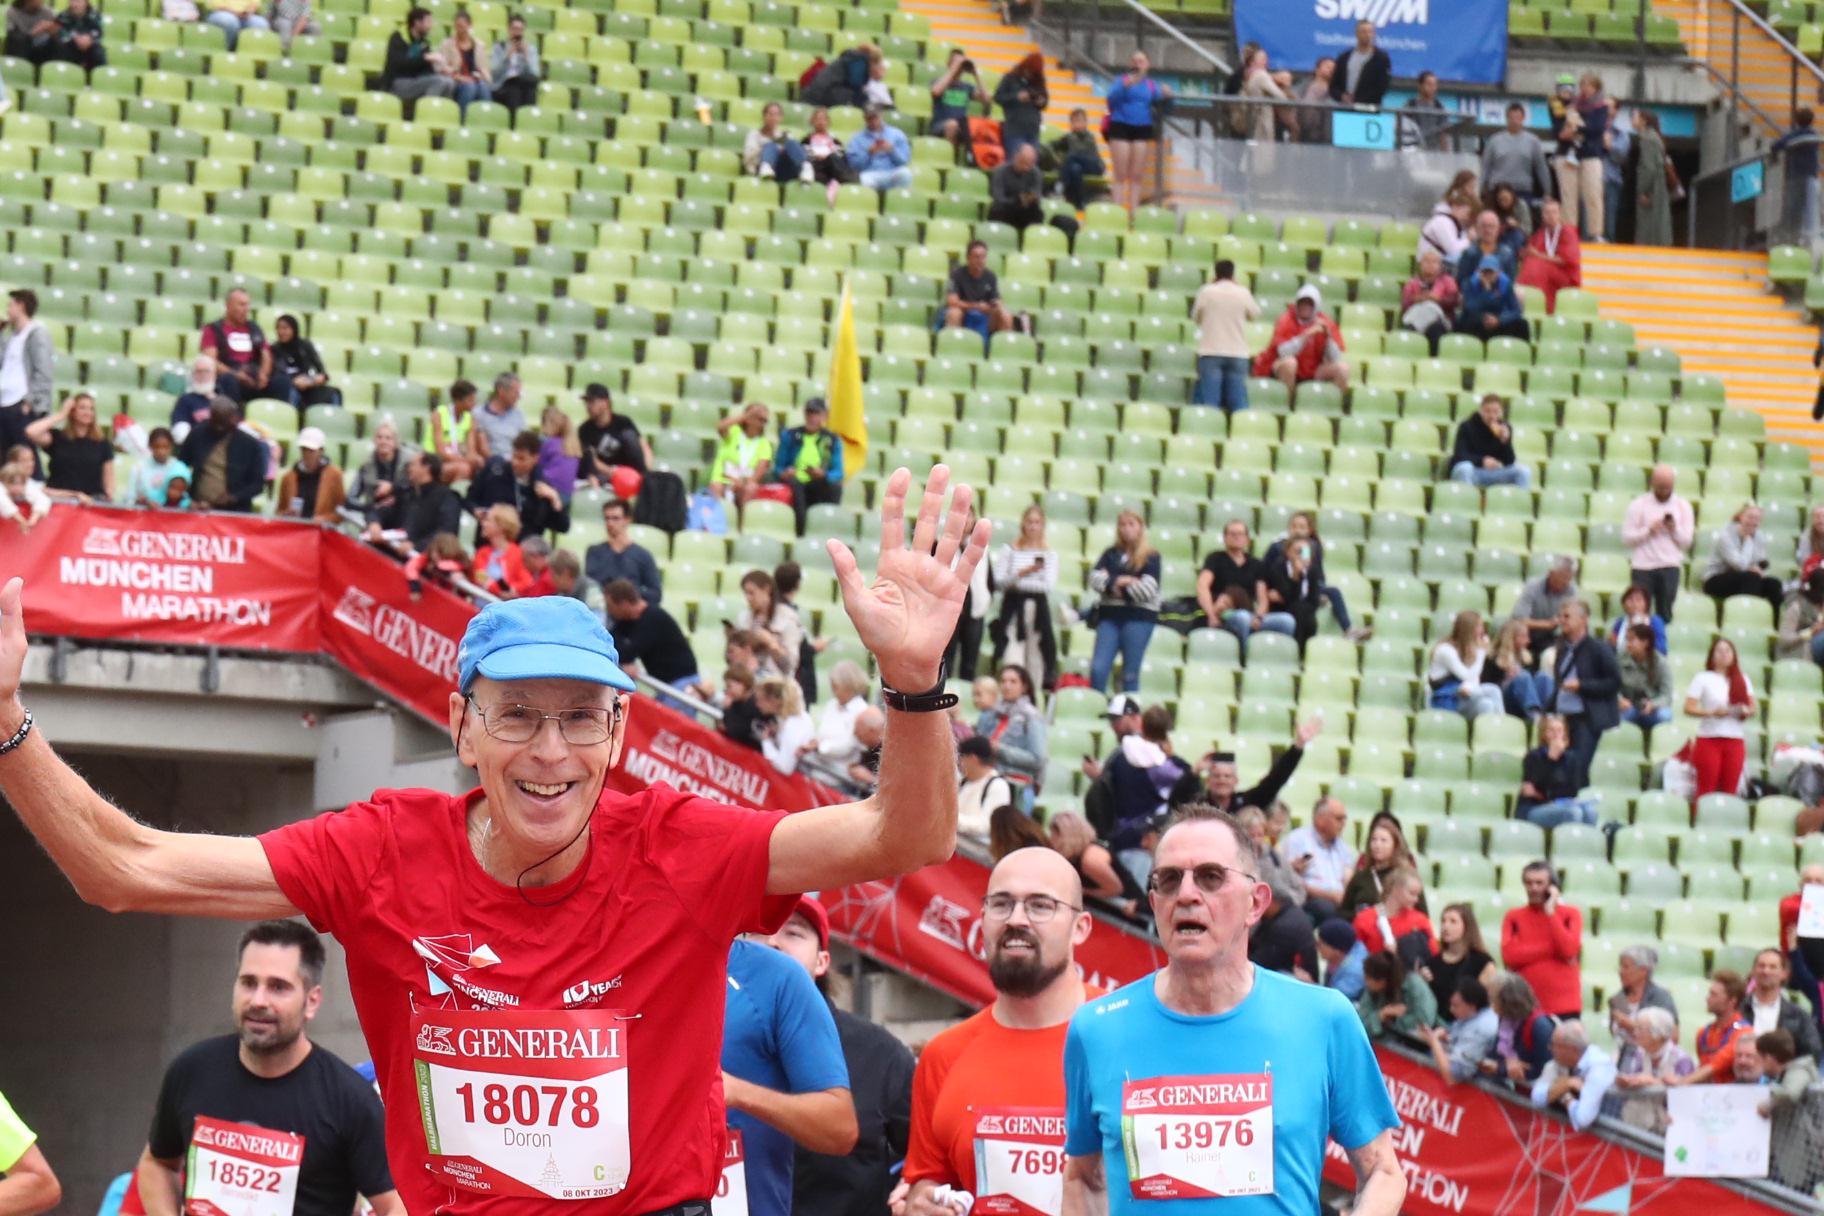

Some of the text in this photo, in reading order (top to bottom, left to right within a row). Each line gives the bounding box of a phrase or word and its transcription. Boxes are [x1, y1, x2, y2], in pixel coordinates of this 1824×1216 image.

[1365, 120, 1382, 142] D
[120, 529, 246, 564] GENERALI
[60, 556, 213, 592] MÜNCHEN
[122, 593, 271, 626] MARATHON
[373, 604, 460, 683] GENER
[678, 740, 769, 806] GENERALI
[458, 1028, 620, 1059] GENERALI
[455, 1082, 600, 1129] 18078
[1158, 1082, 1268, 1106] GENERALI
[1383, 1074, 1466, 1137] NERALI
[214, 1130, 300, 1161] GENERALI
[504, 1127, 552, 1148] Doron
[1154, 1119, 1254, 1150] 13976
[209, 1159, 282, 1193] 18522
[456, 1177, 491, 1190] MARATHON
[593, 1164, 606, 1181] C
[562, 1188, 614, 1198] 08 OKT 2023
